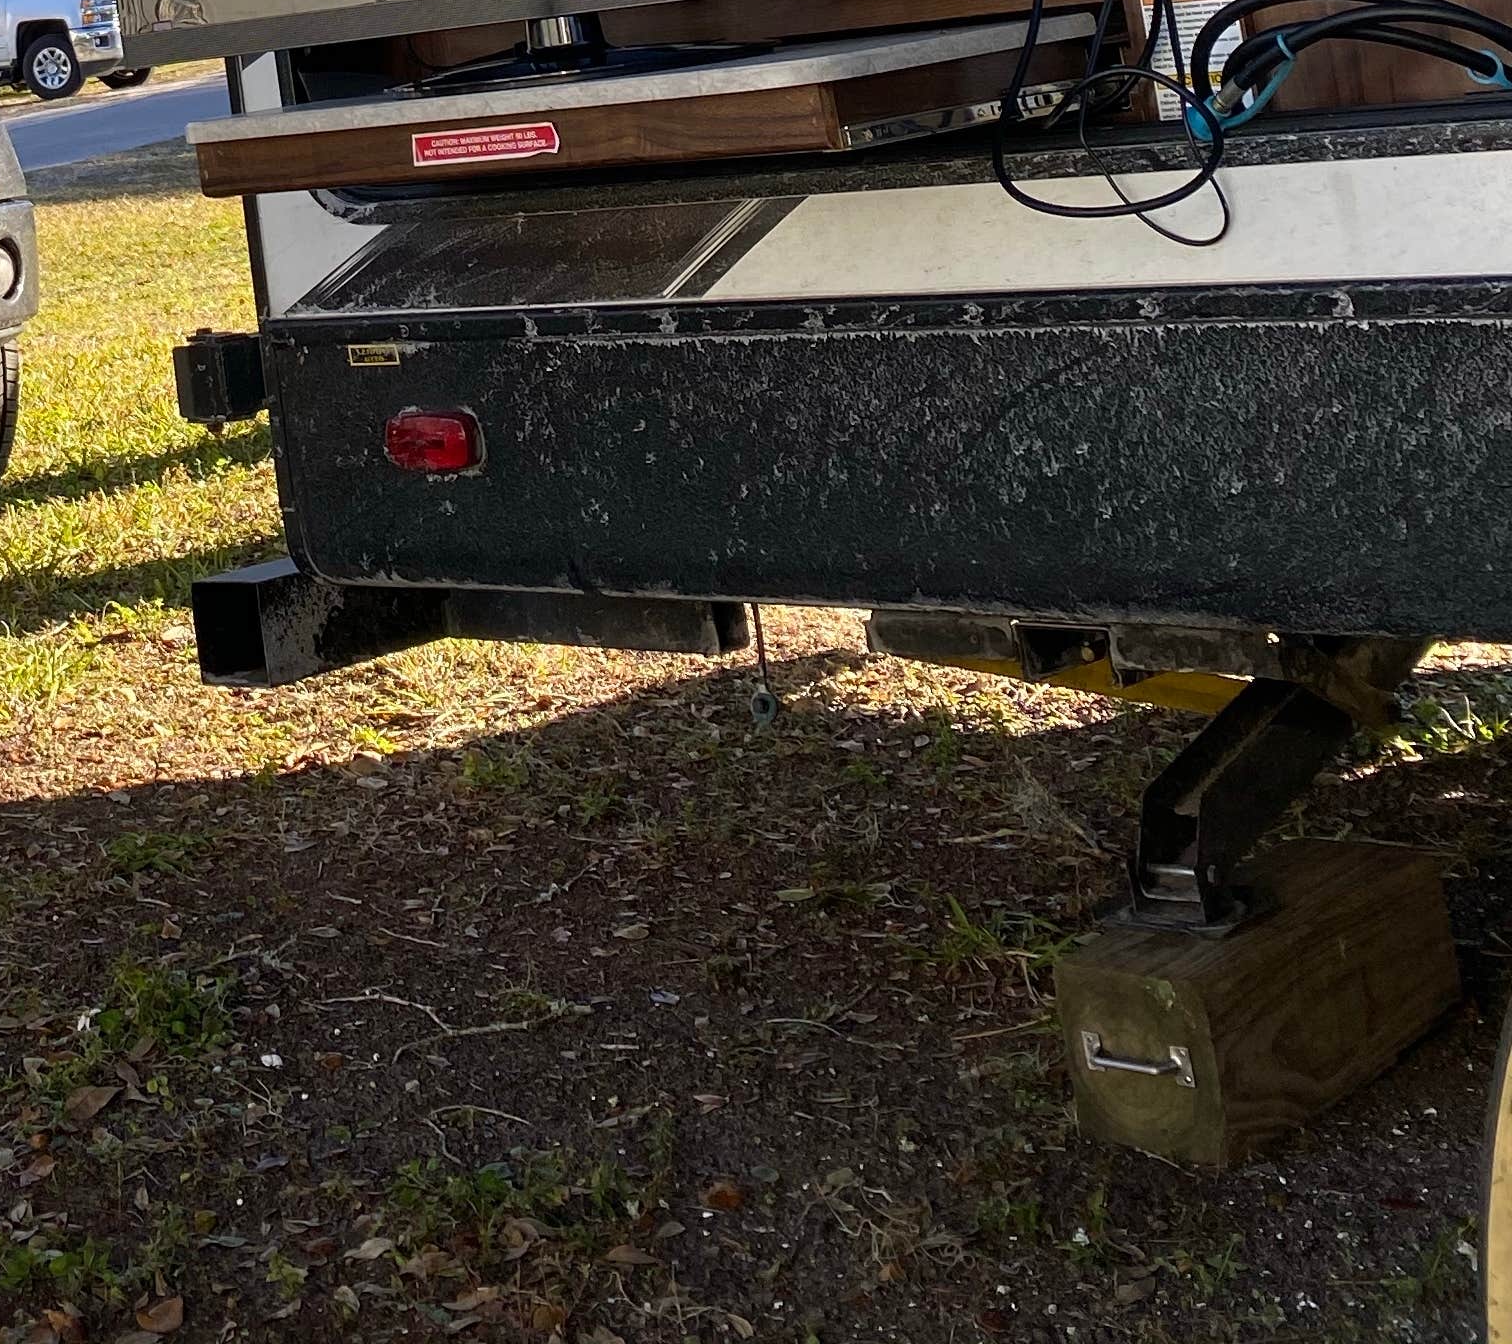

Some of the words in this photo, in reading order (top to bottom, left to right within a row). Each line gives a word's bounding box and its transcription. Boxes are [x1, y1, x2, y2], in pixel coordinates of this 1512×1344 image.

[424, 149, 437, 157] NOT
[468, 144, 481, 153] FOR
[487, 141, 517, 151] COOKING
